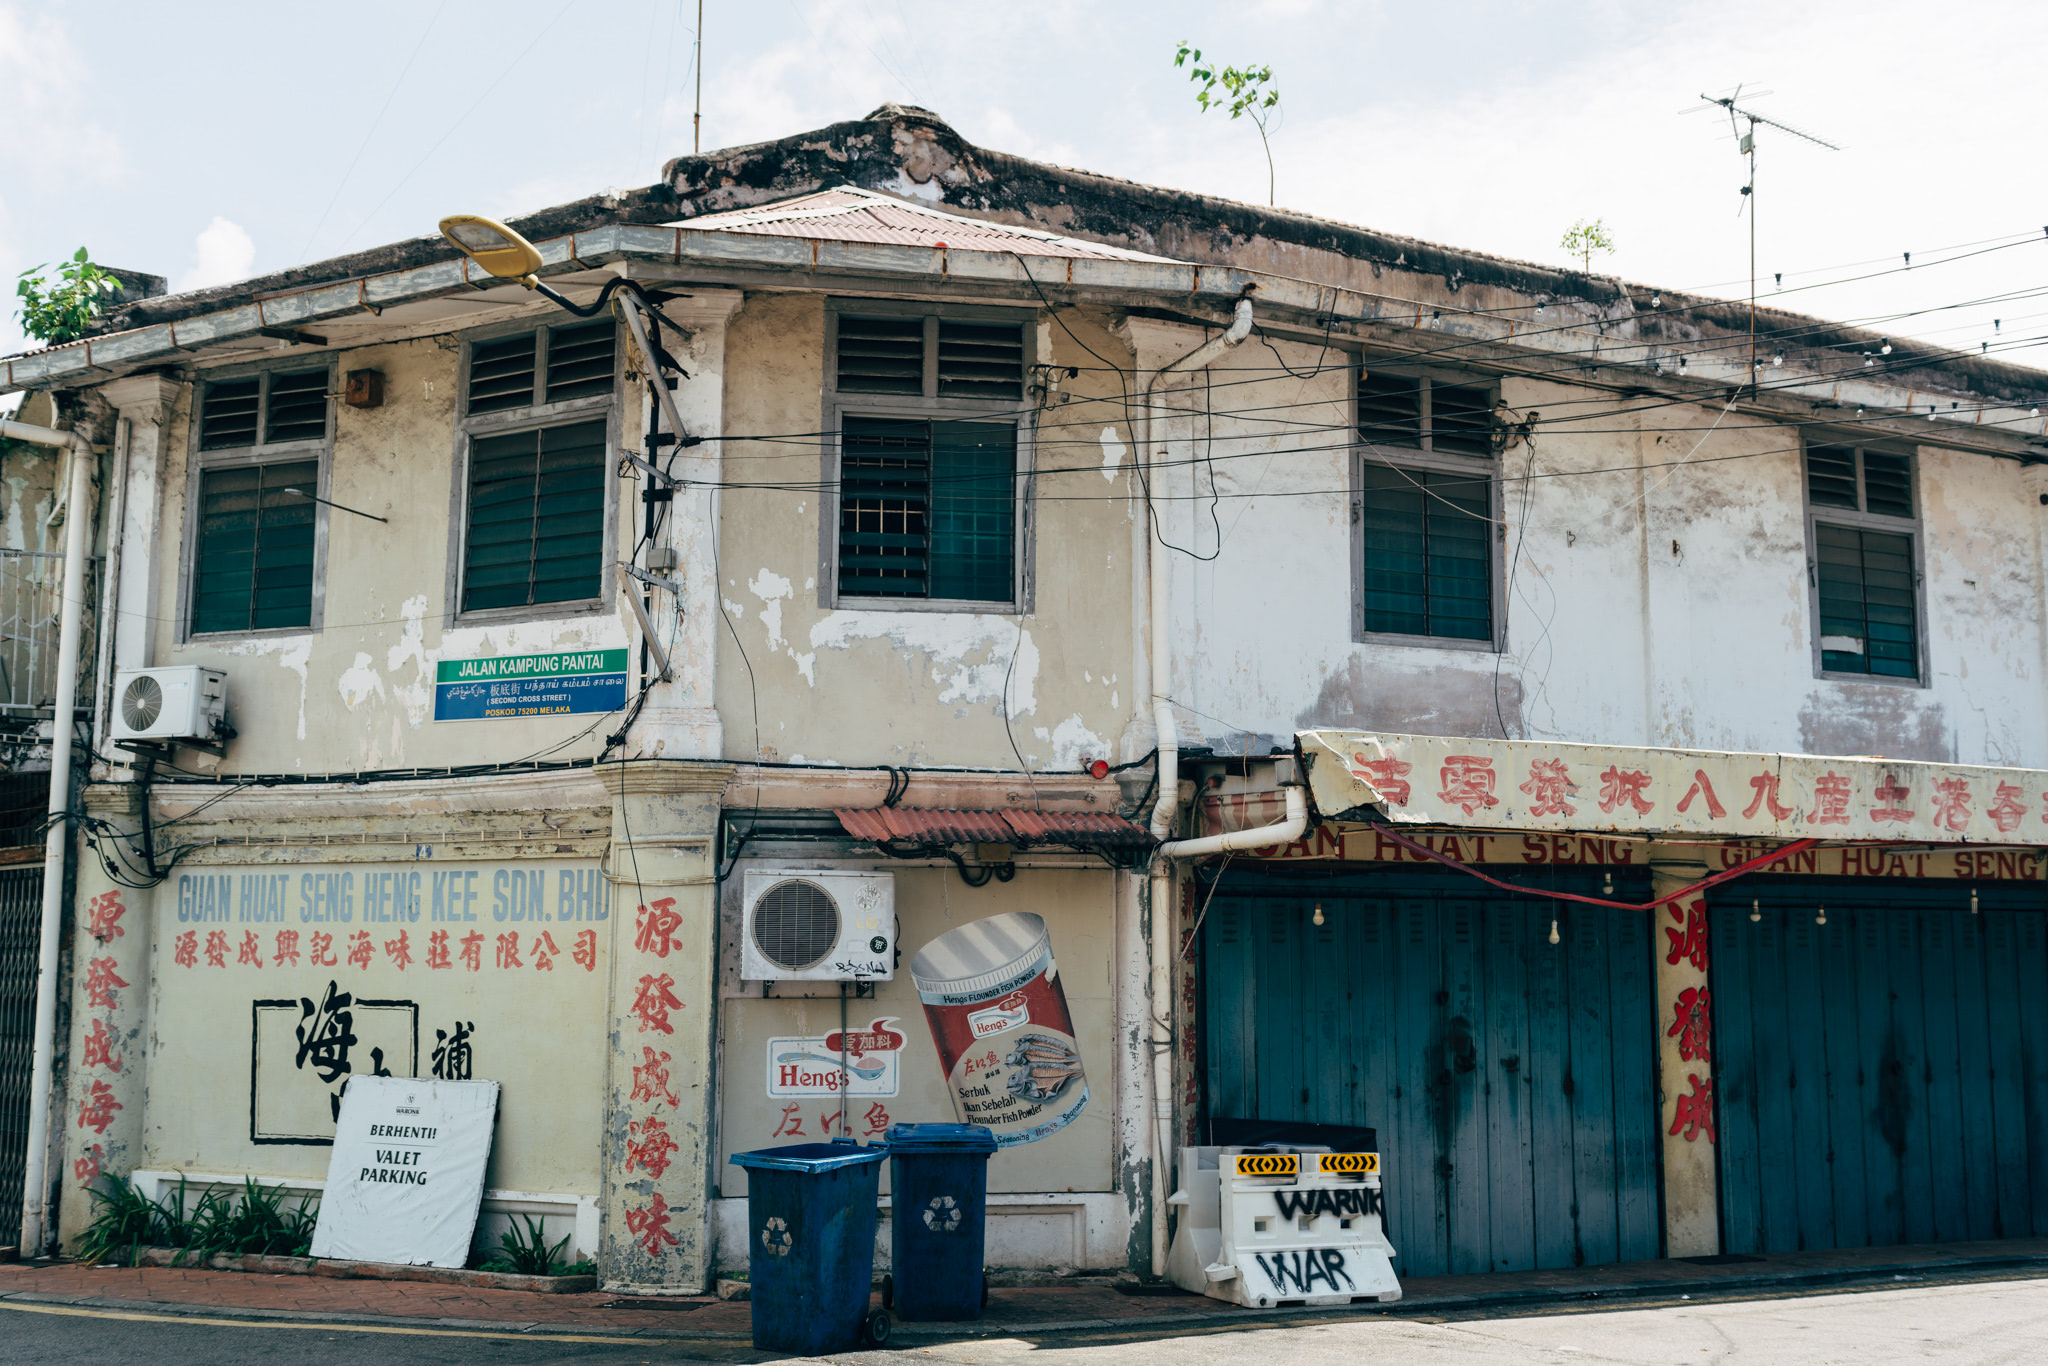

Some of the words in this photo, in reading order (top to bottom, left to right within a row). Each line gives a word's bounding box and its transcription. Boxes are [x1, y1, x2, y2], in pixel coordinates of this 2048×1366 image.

[459, 660, 497, 677] JALAN
[499, 656, 559, 675] KAMPUNG
[562, 654, 604, 671] PANTAI
[490, 683, 521, 697] 板底街
[518, 695, 541, 704] CROSS
[485, 708, 516, 717] POSKOD
[518, 707, 538, 716] 75200
[540, 705, 571, 715] MELAKA
[1521, 834, 1633, 865] SENG
[1841, 846, 1931, 877] HUAT
[1953, 850, 2039, 881] SENG
[178, 874, 232, 923] GUAN
[239, 874, 290, 923] HUAT
[300, 872, 354, 923] SENG
[363, 871, 422, 923] HENG
[431, 870, 479, 922] KEE
[493, 869, 552, 922] SDN.
[558, 869, 610, 922] BHD
[856, 916, 878, 930] LG
[968, 988, 1001, 1002] FLOUNDER
[1001, 983, 1014, 993] FISH
[1014, 968, 1037, 987] POWDER
[976, 1018, 1008, 1034] Heng's
[625, 896, 687, 1257] 源發成海味
[779, 1064, 850, 1091] Heng's
[959, 1083, 991, 1099] Serbuk
[963, 1102, 982, 1112] Ikan
[982, 1095, 1017, 1112] Sebelah
[966, 1114, 1002, 1126] Flounder
[1002, 1111, 1019, 1124] Fish
[1019, 1103, 1043, 1121] Powder
[370, 1124, 438, 1140] BERHENTI!
[376, 1150, 421, 1166] VALET
[360, 1167, 428, 1185] PARKING
[1256, 1248, 1356, 1295] WAR
